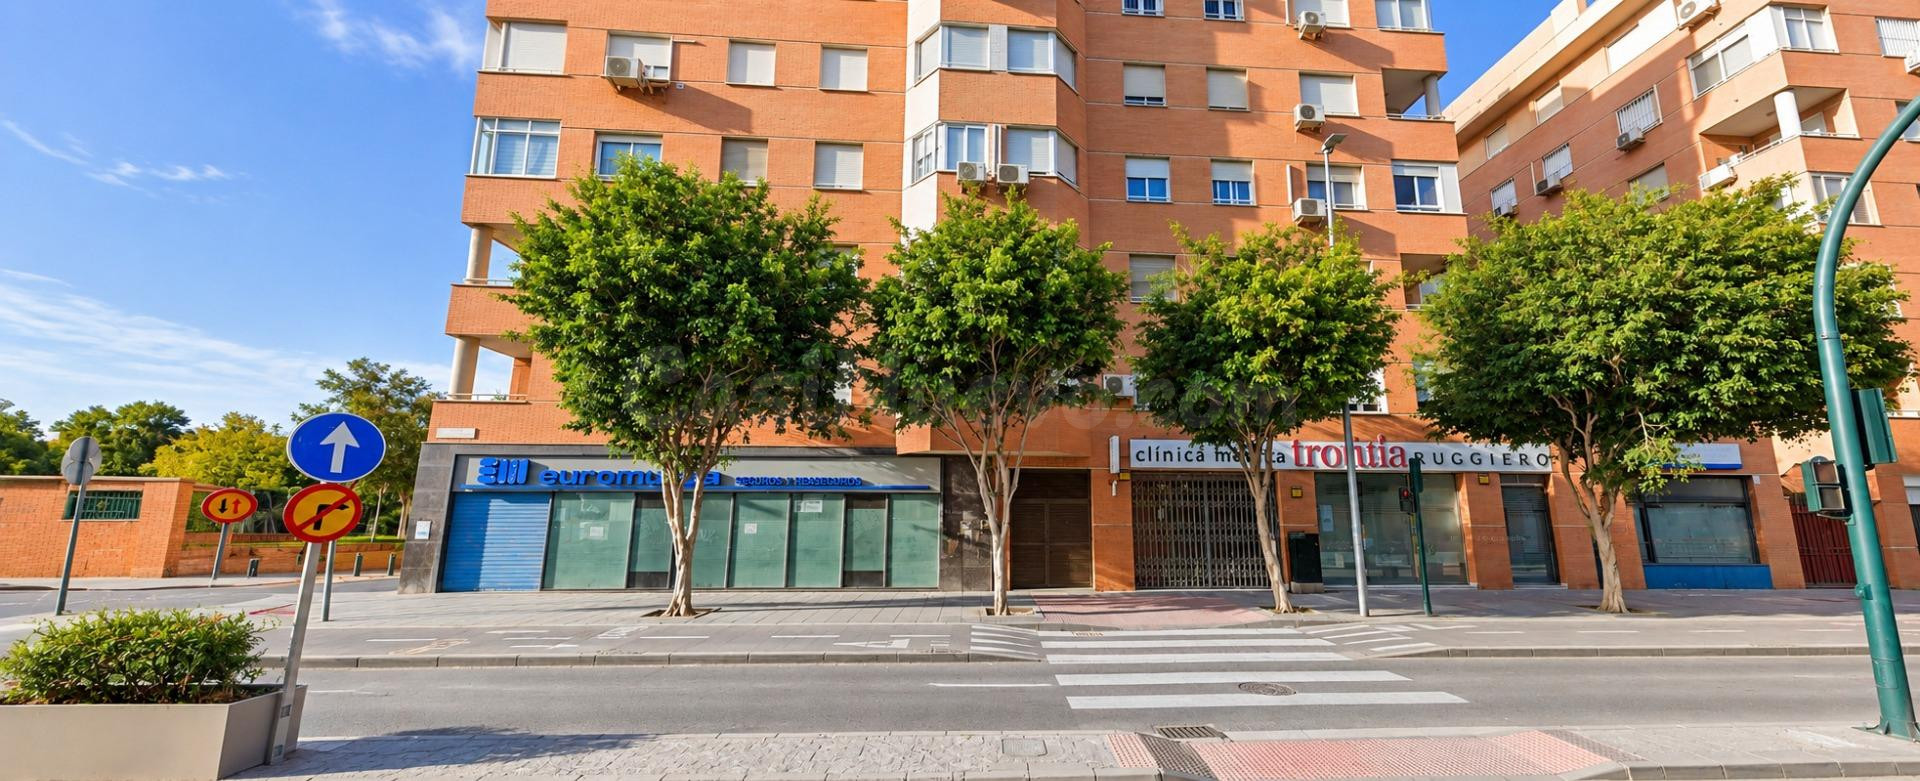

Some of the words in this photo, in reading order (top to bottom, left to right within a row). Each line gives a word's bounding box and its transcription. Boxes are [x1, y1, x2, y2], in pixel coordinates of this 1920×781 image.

[1135, 446, 1205, 463] clínica
[1414, 451, 1549, 467] RUGGIERO
[735, 477, 782, 487] SEGUROS
